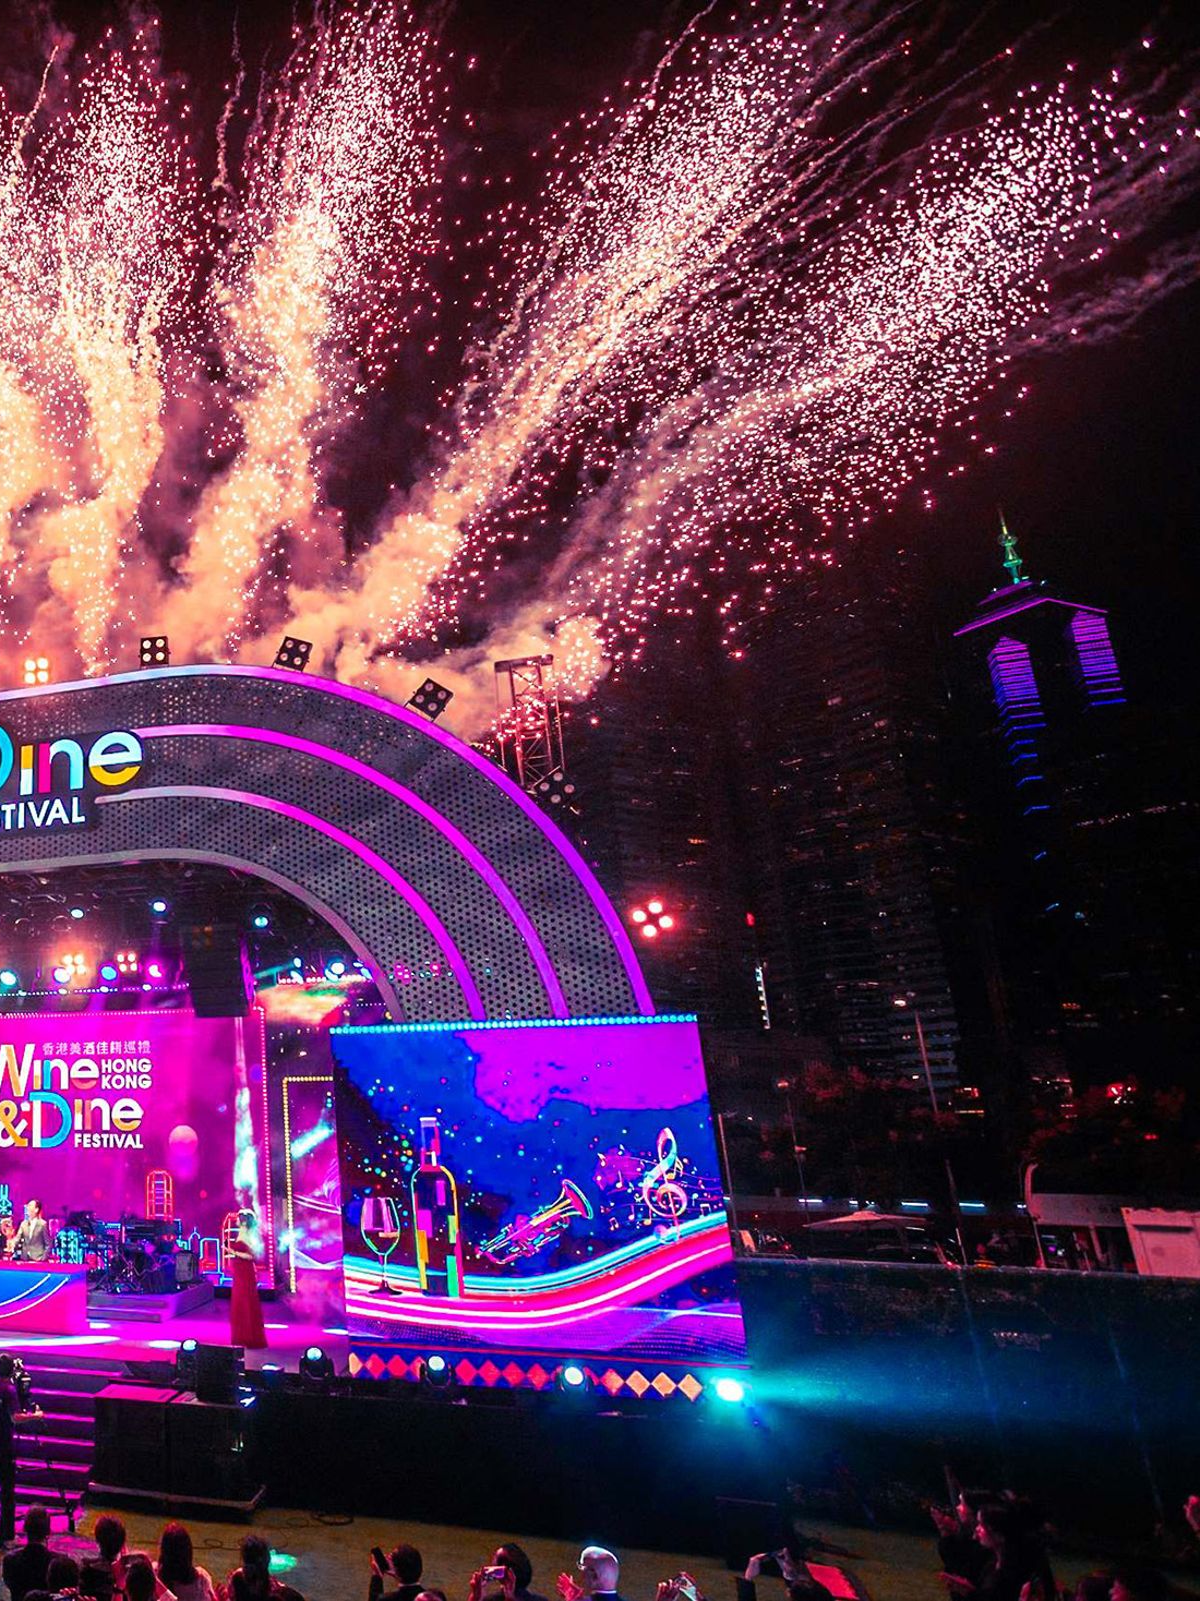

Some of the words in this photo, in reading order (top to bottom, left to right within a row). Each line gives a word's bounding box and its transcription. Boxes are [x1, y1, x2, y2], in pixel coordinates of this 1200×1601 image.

[101, 1058, 152, 1073] HONG
[101, 1074, 152, 1090] KONG
[29, 1091, 144, 1148] Dine
[74, 1133, 144, 1149] FESTIVAL
